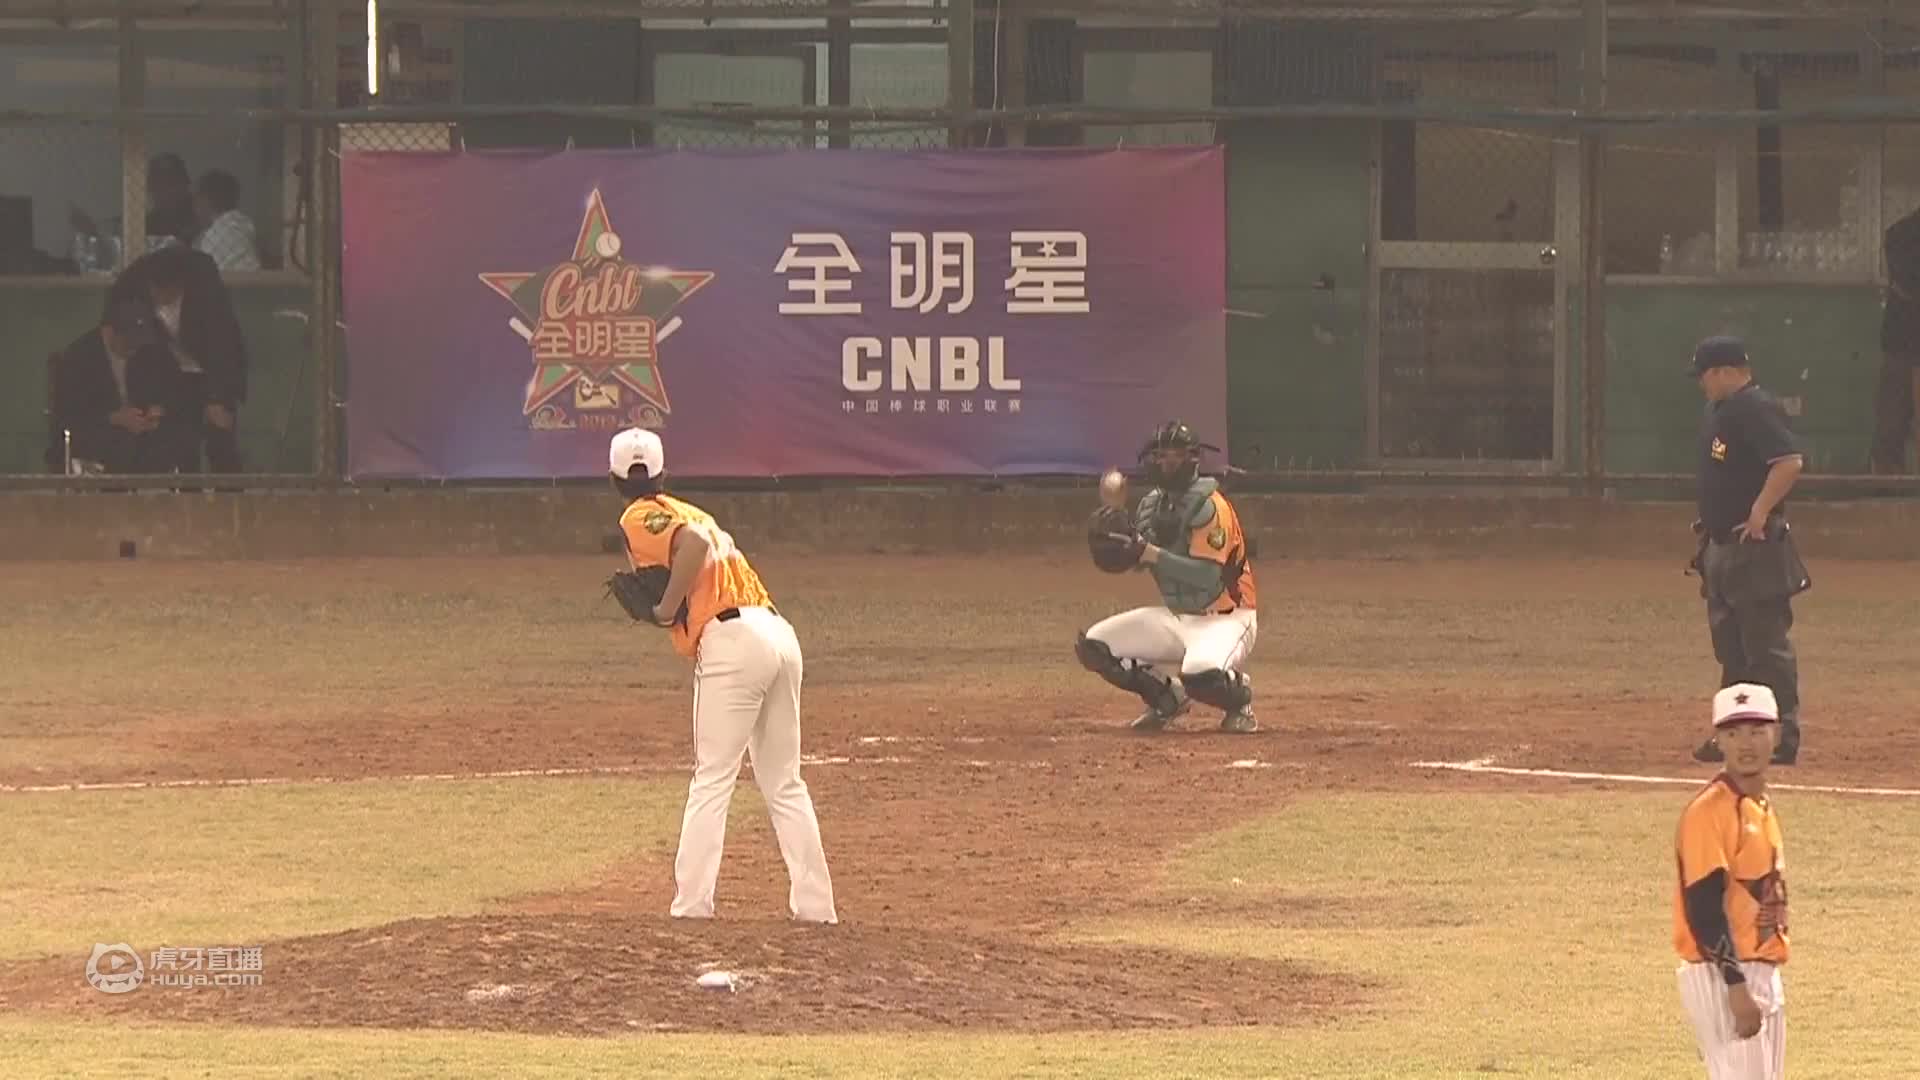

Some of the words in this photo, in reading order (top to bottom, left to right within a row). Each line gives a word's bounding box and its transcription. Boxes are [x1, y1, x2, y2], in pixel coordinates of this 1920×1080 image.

[774, 231, 1090, 314] 全明星
[535, 321, 652, 359] 全明星
[842, 336, 1022, 392] CNBL
[842, 399, 1022, 413] 中国棒球职业联赛
